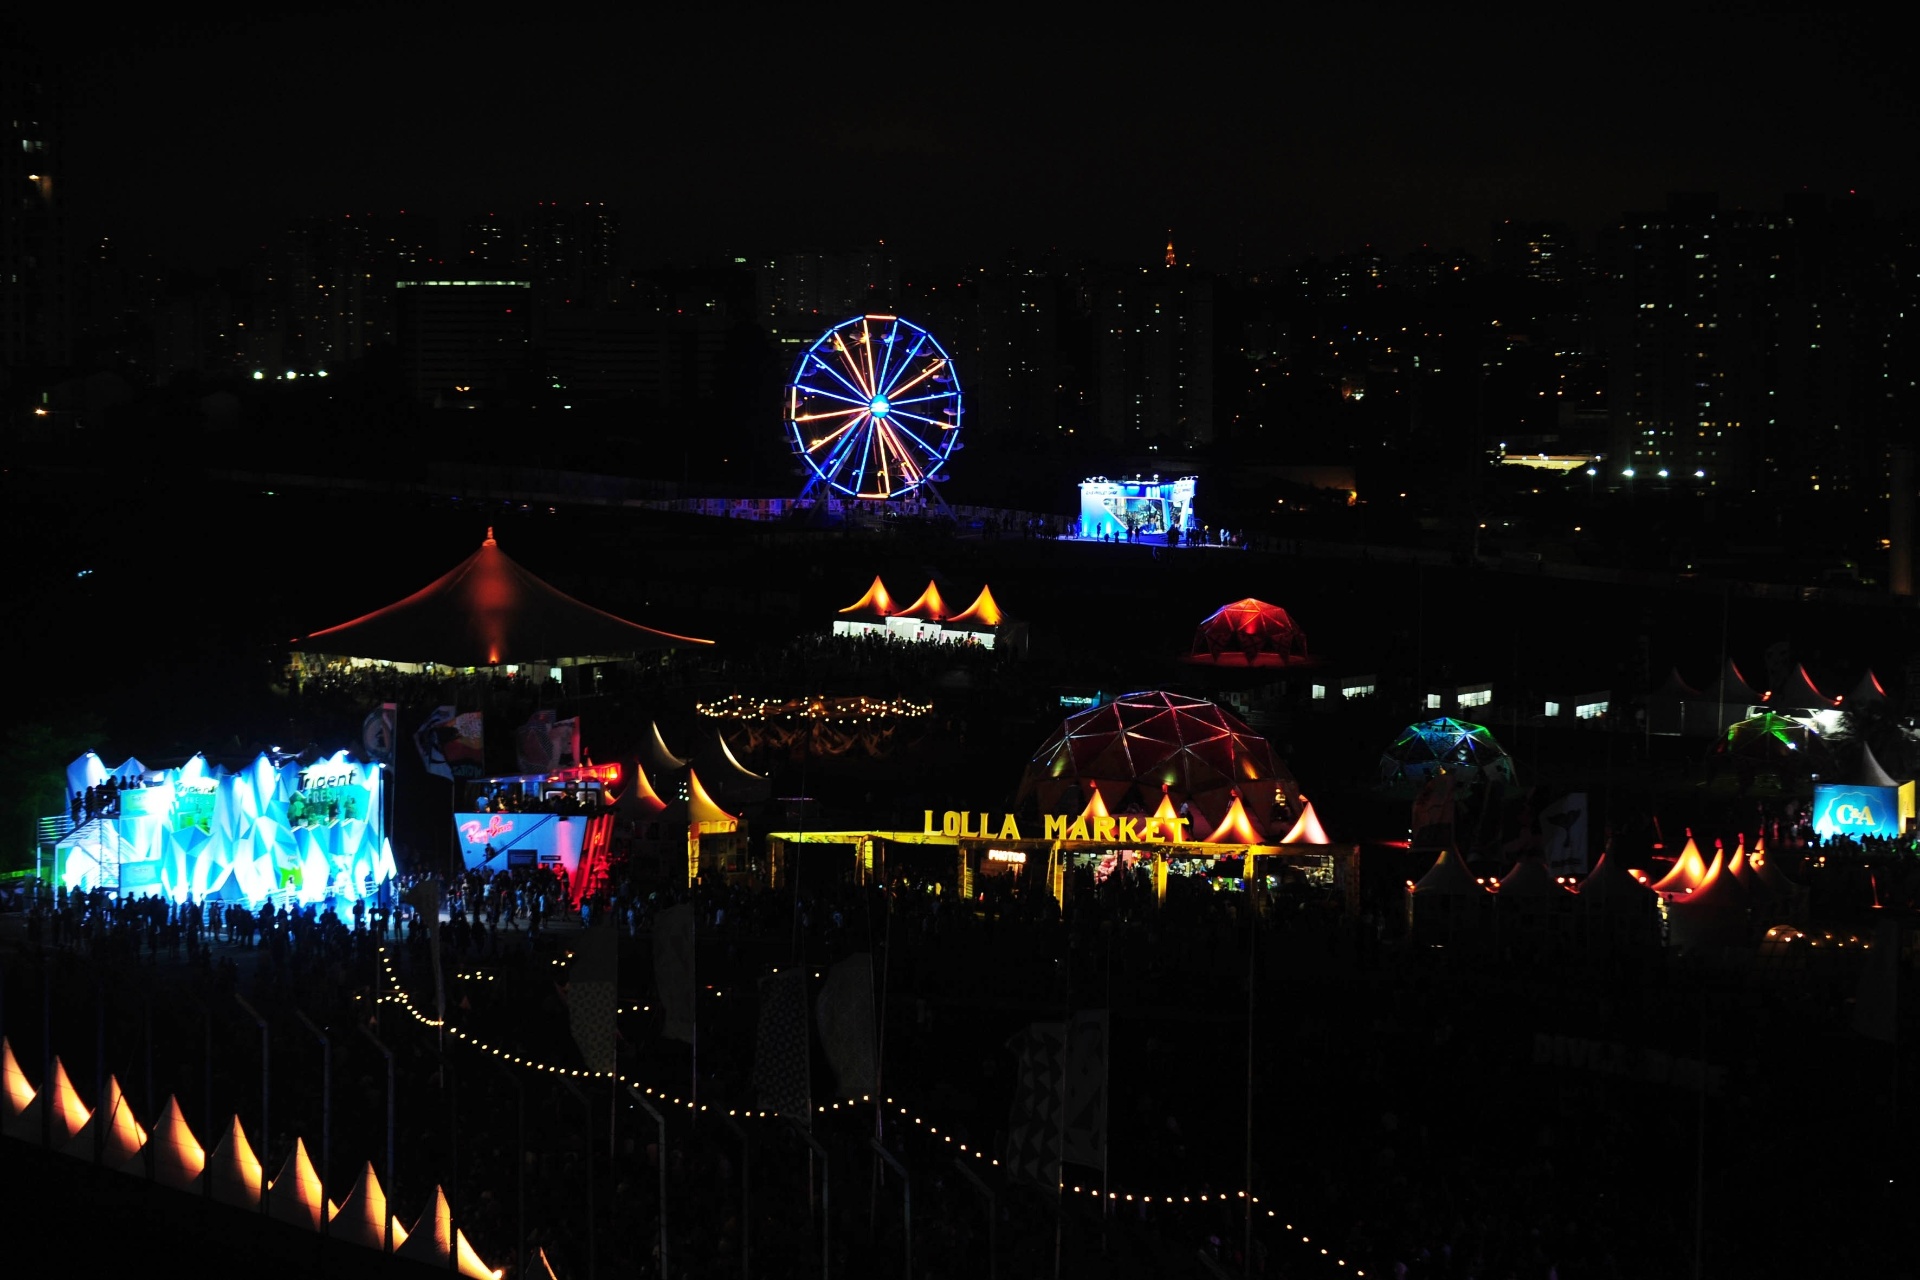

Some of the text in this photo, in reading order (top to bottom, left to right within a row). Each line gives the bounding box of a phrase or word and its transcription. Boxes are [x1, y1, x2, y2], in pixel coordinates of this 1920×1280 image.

[305, 789, 341, 804] FRESH
[1836, 804, 1876, 825] C&A
[924, 810, 1190, 843] LOLLA MARKET
